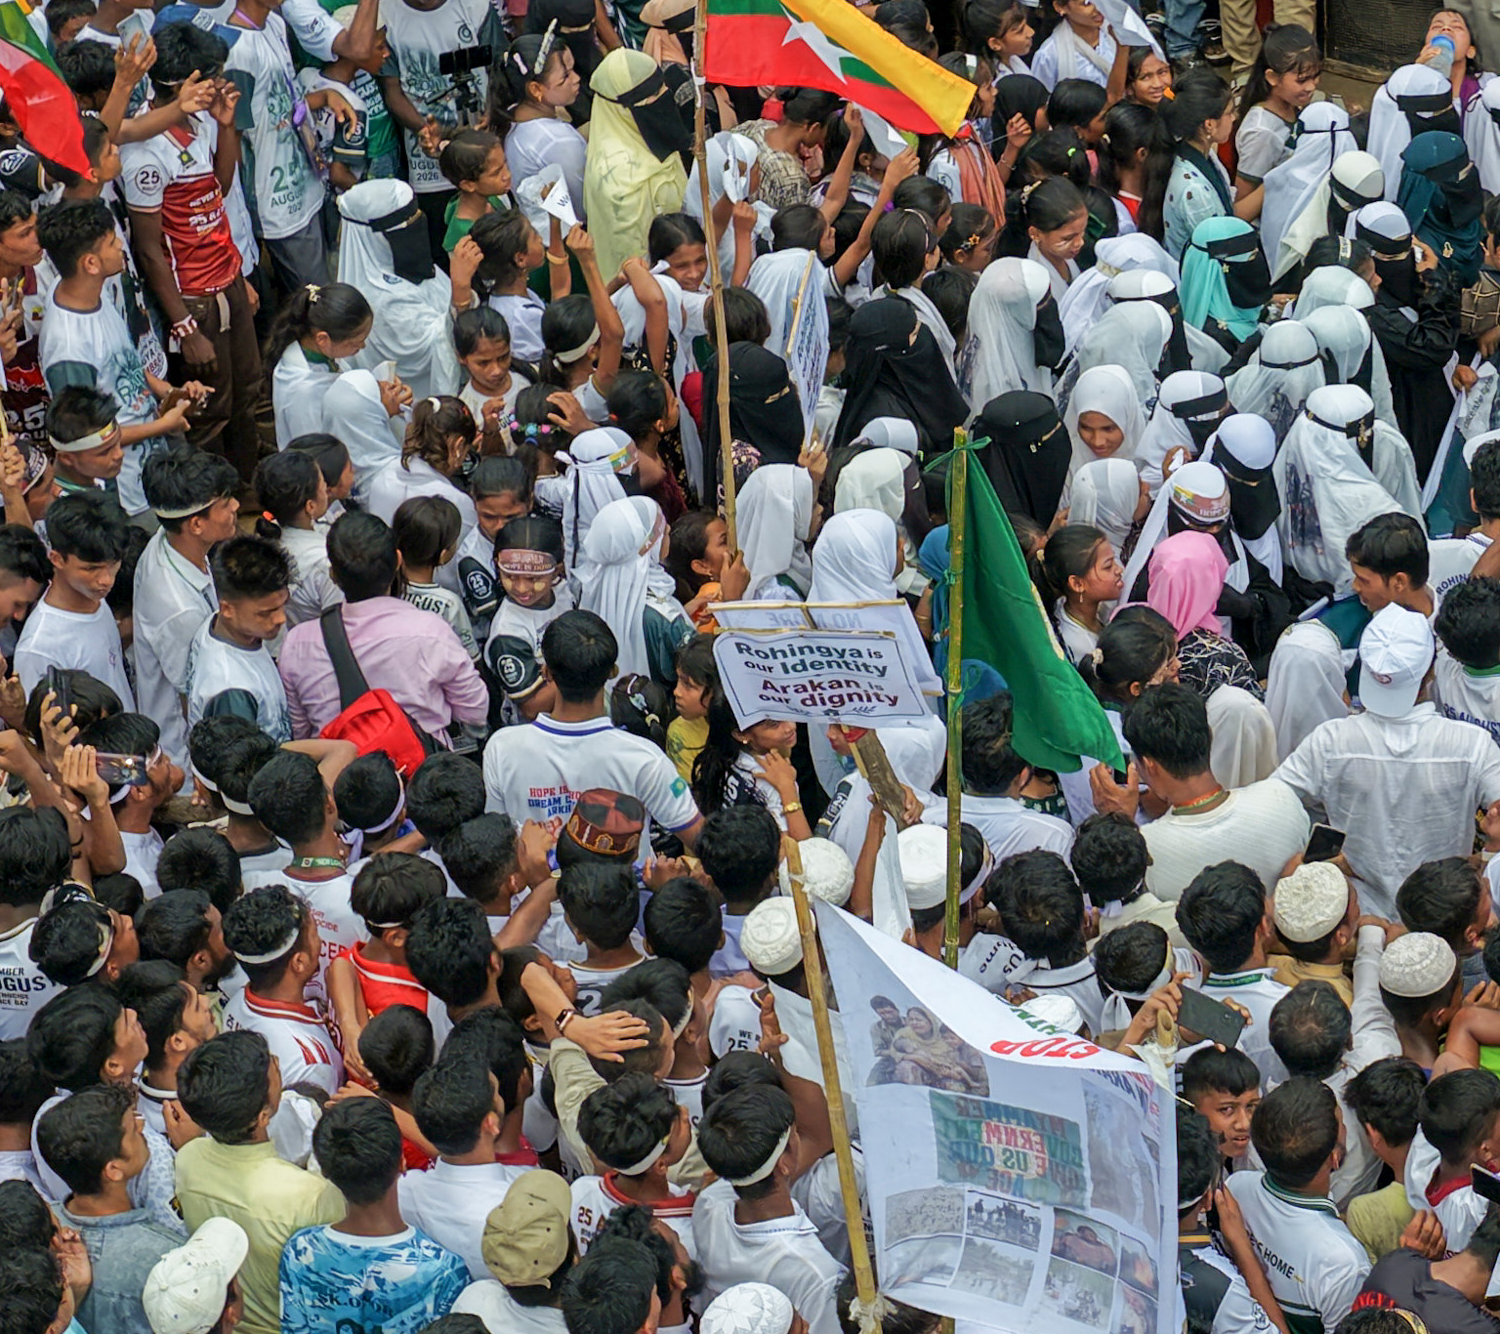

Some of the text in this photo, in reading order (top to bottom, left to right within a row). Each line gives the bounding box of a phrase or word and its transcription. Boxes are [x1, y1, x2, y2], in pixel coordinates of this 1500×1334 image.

[733, 640, 883, 661] Rohingya is
[744, 660, 775, 677] our
[761, 677, 885, 695] Arakan is
[757, 691, 900, 709] our dignity
